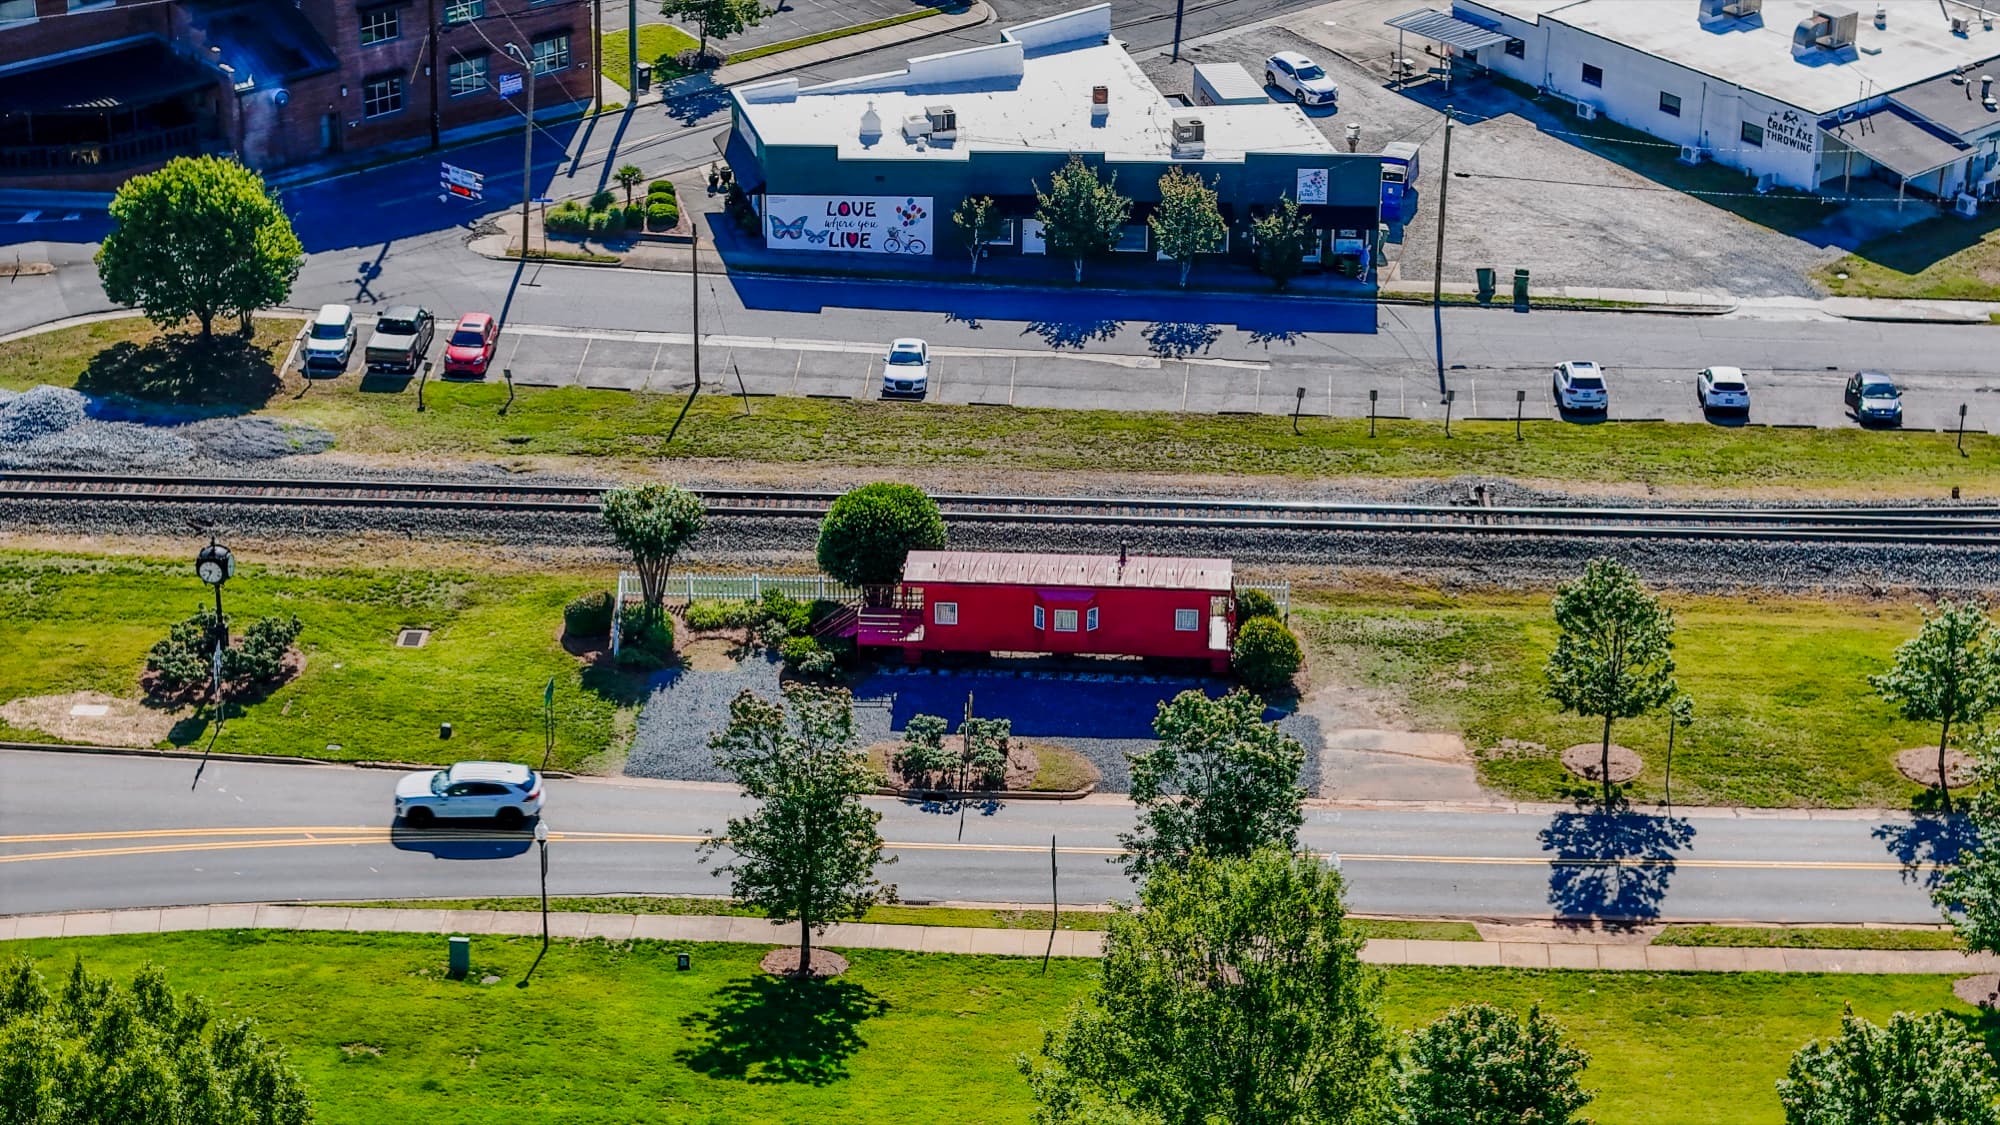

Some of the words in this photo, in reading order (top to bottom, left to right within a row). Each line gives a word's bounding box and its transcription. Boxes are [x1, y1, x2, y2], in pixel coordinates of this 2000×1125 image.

[1767, 118, 1794, 136] CRAFT
[1796, 126, 1813, 143] AXE
[1766, 129, 1812, 153] THROWING
[827, 201, 877, 217] LOVE
[824, 216, 855, 230] where
[857, 220, 878, 231] you
[828, 231, 872, 249] LIVE
